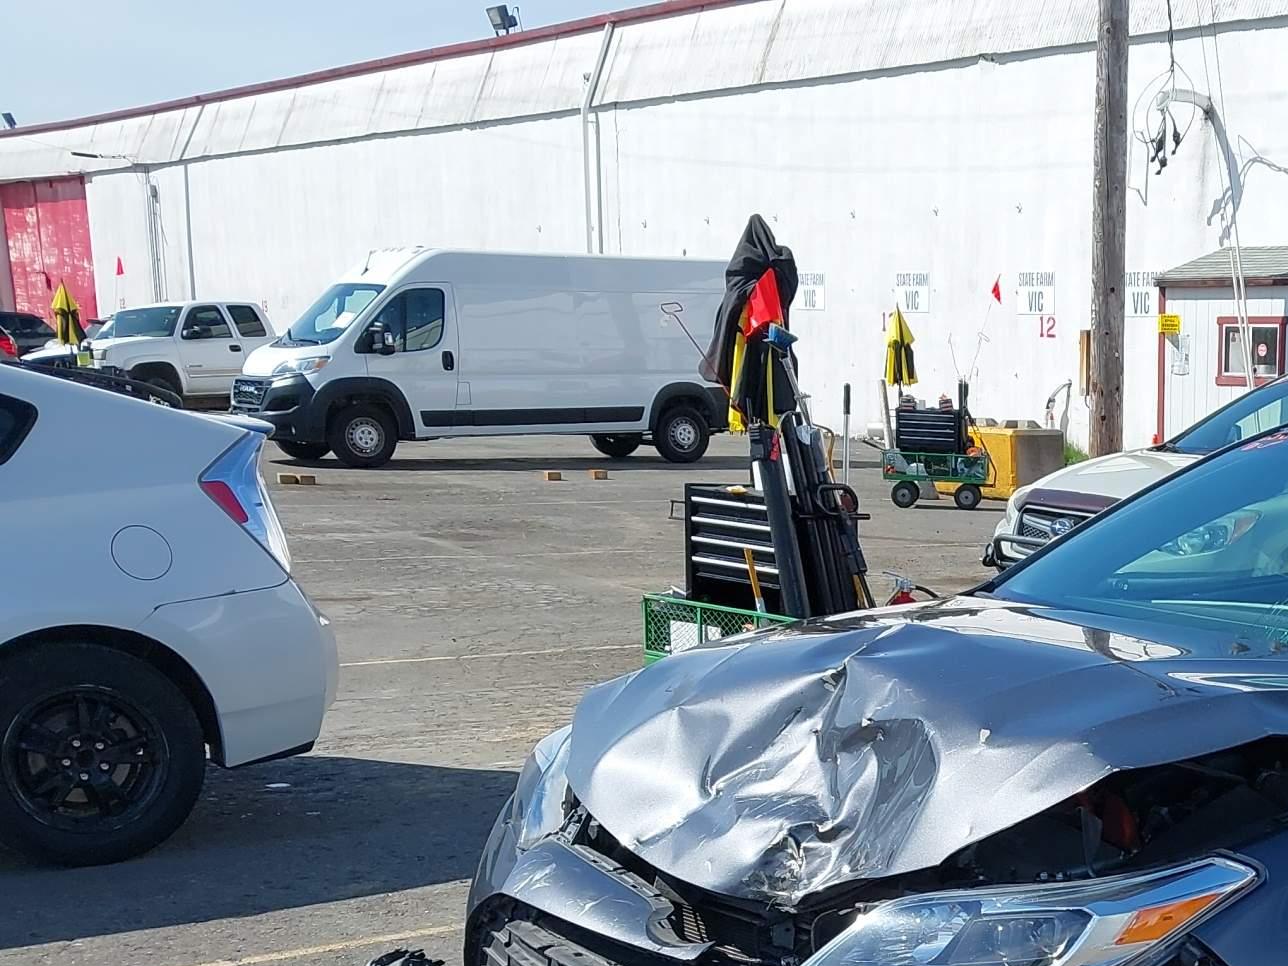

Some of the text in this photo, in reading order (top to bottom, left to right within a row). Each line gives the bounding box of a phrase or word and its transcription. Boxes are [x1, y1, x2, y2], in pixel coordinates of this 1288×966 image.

[798, 272, 809, 286] TATE
[896, 273, 928, 287] STATE FARM
[1018, 272, 1055, 287] STATE FARM
[1125, 272, 1140, 287] TATE
[804, 289, 816, 308] VIC
[905, 290, 919, 310] VIC
[1028, 291, 1043, 312] VIC
[1132, 291, 1150, 314] VIC
[1039, 316, 1056, 338] 12
